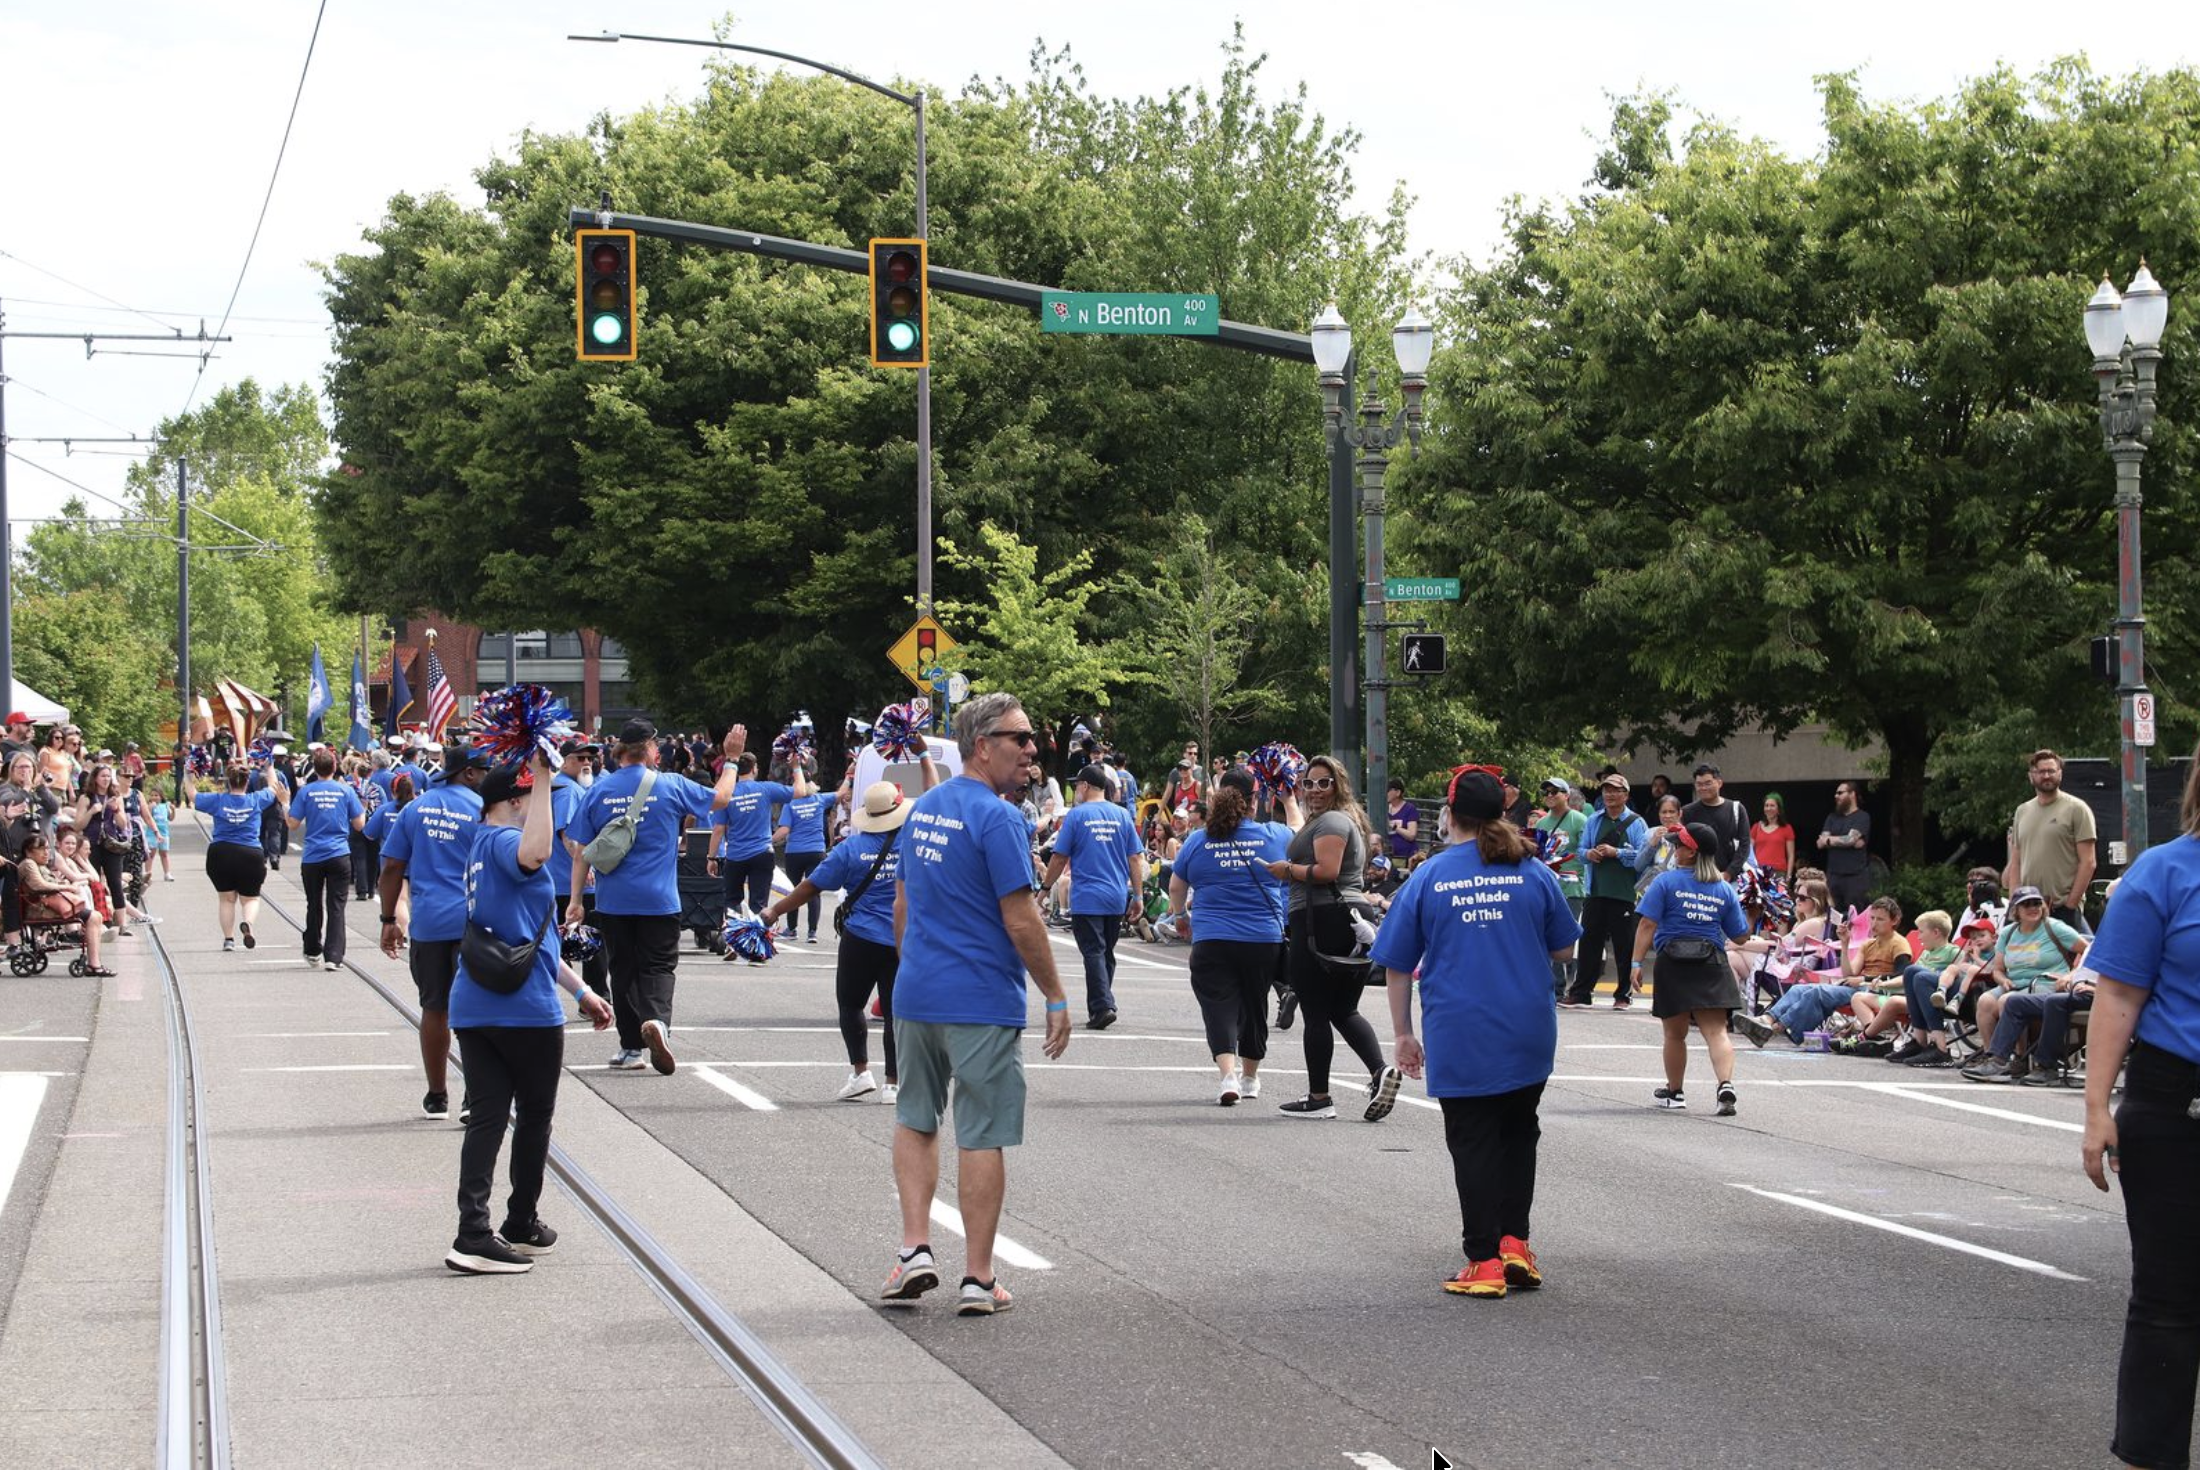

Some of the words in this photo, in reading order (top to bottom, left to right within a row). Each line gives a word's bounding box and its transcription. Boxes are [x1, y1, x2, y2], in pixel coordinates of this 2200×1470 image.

[1184, 299, 1206, 312] 400
[1078, 309, 1089, 324] N
[1097, 302, 1171, 326] Benton
[1397, 583, 1442, 596] Benton
[417, 806, 441, 815] Green
[422, 815, 439, 826] Are
[427, 828, 438, 838] Of
[438, 830, 455, 840] This
[1204, 841, 1231, 850] Green
[860, 852, 879, 861] Gree
[1220, 859, 1231, 868] Of
[1434, 879, 1473, 892] Green
[1474, 875, 1524, 887] Dreams
[1452, 895, 1474, 907] Are
[1475, 890, 1510, 903] Made
[1675, 890, 1697, 900] Green
[1682, 901, 1697, 909] Are
[1697, 903, 1718, 912] Made
[1462, 909, 1477, 922] Of
[1478, 908, 1503, 920] This
[1686, 911, 1697, 920] Of
[1698, 913, 1713, 922] This
